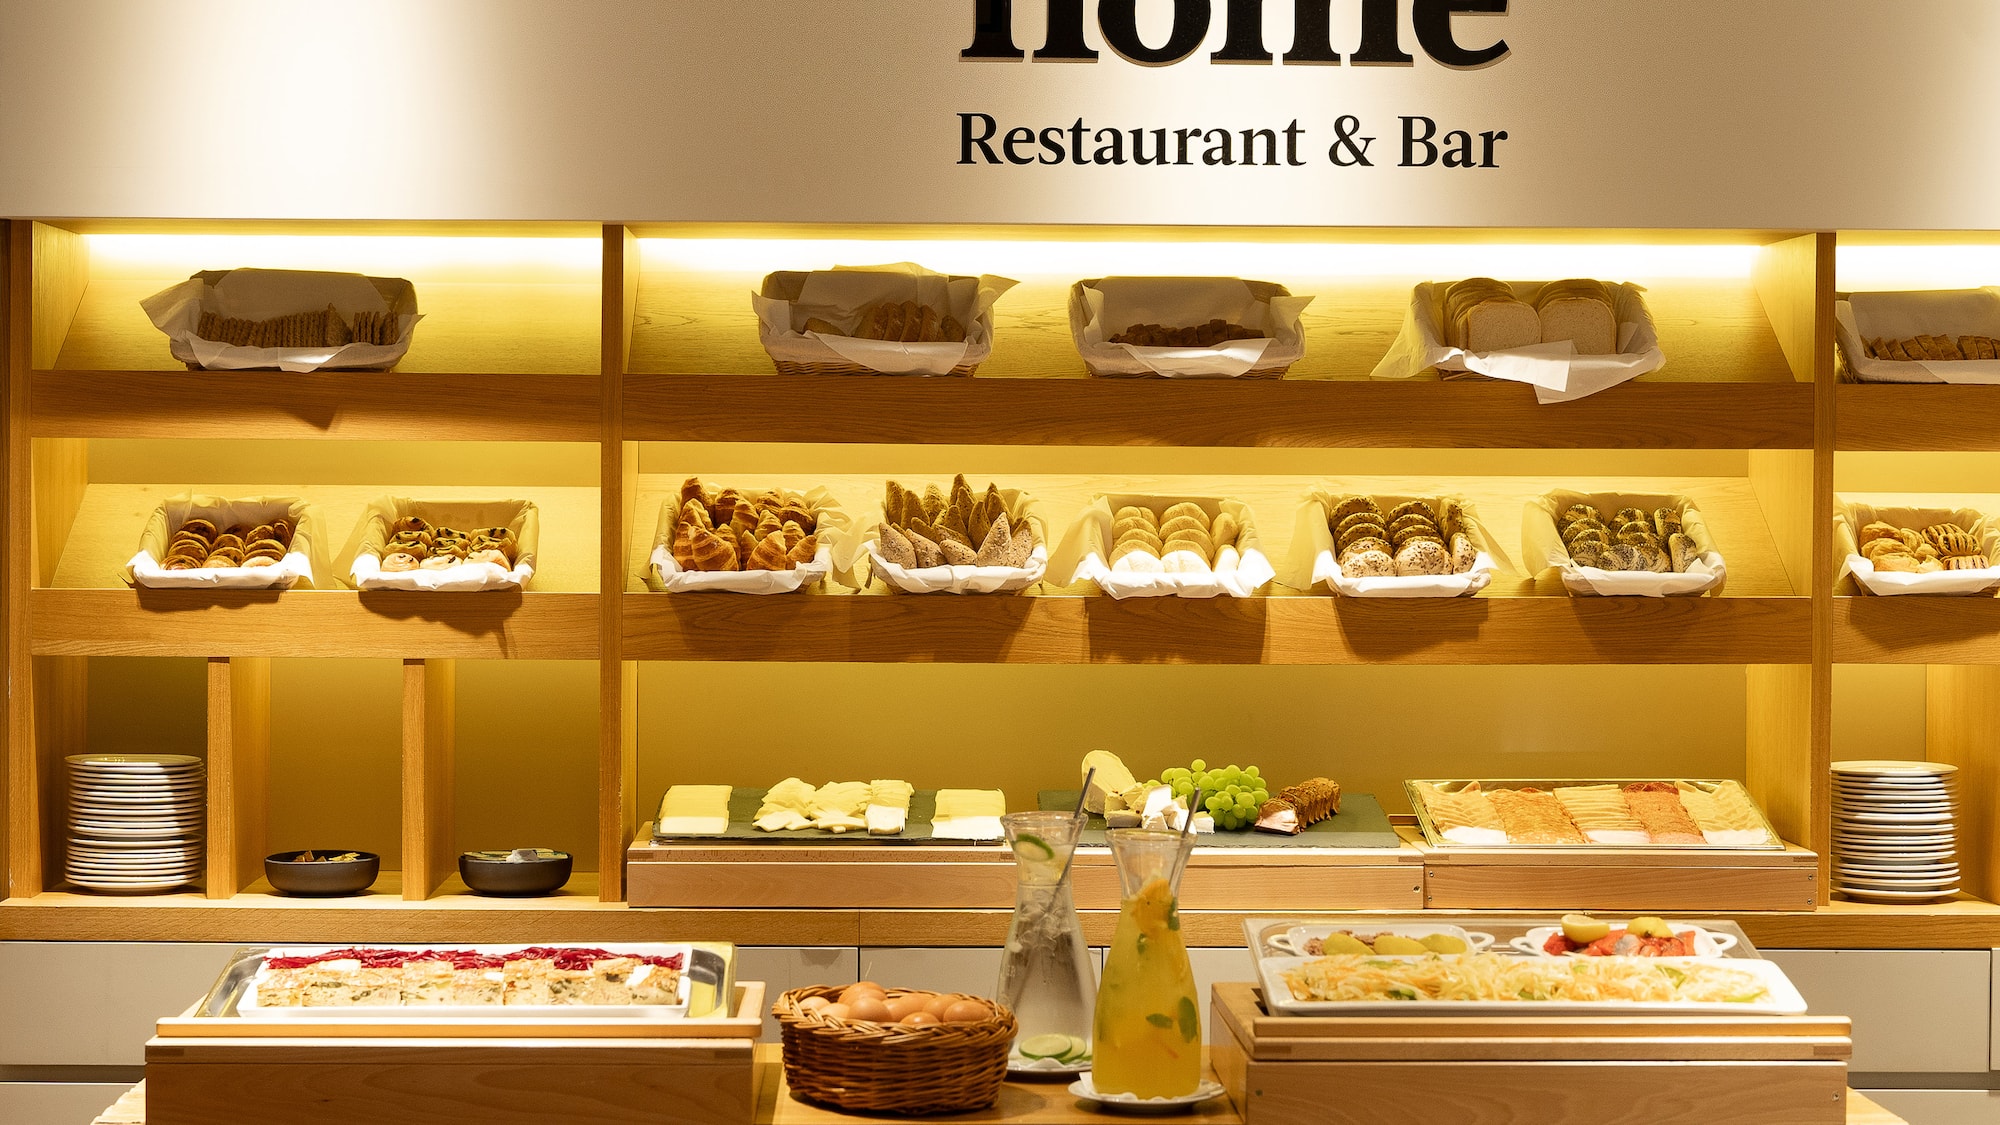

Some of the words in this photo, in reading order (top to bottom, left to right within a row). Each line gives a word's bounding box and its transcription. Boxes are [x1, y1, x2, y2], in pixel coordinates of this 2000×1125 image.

[956, 112, 1307, 167] Restaurant
[1328, 114, 1377, 167] &
[1397, 115, 1509, 168] Bar
